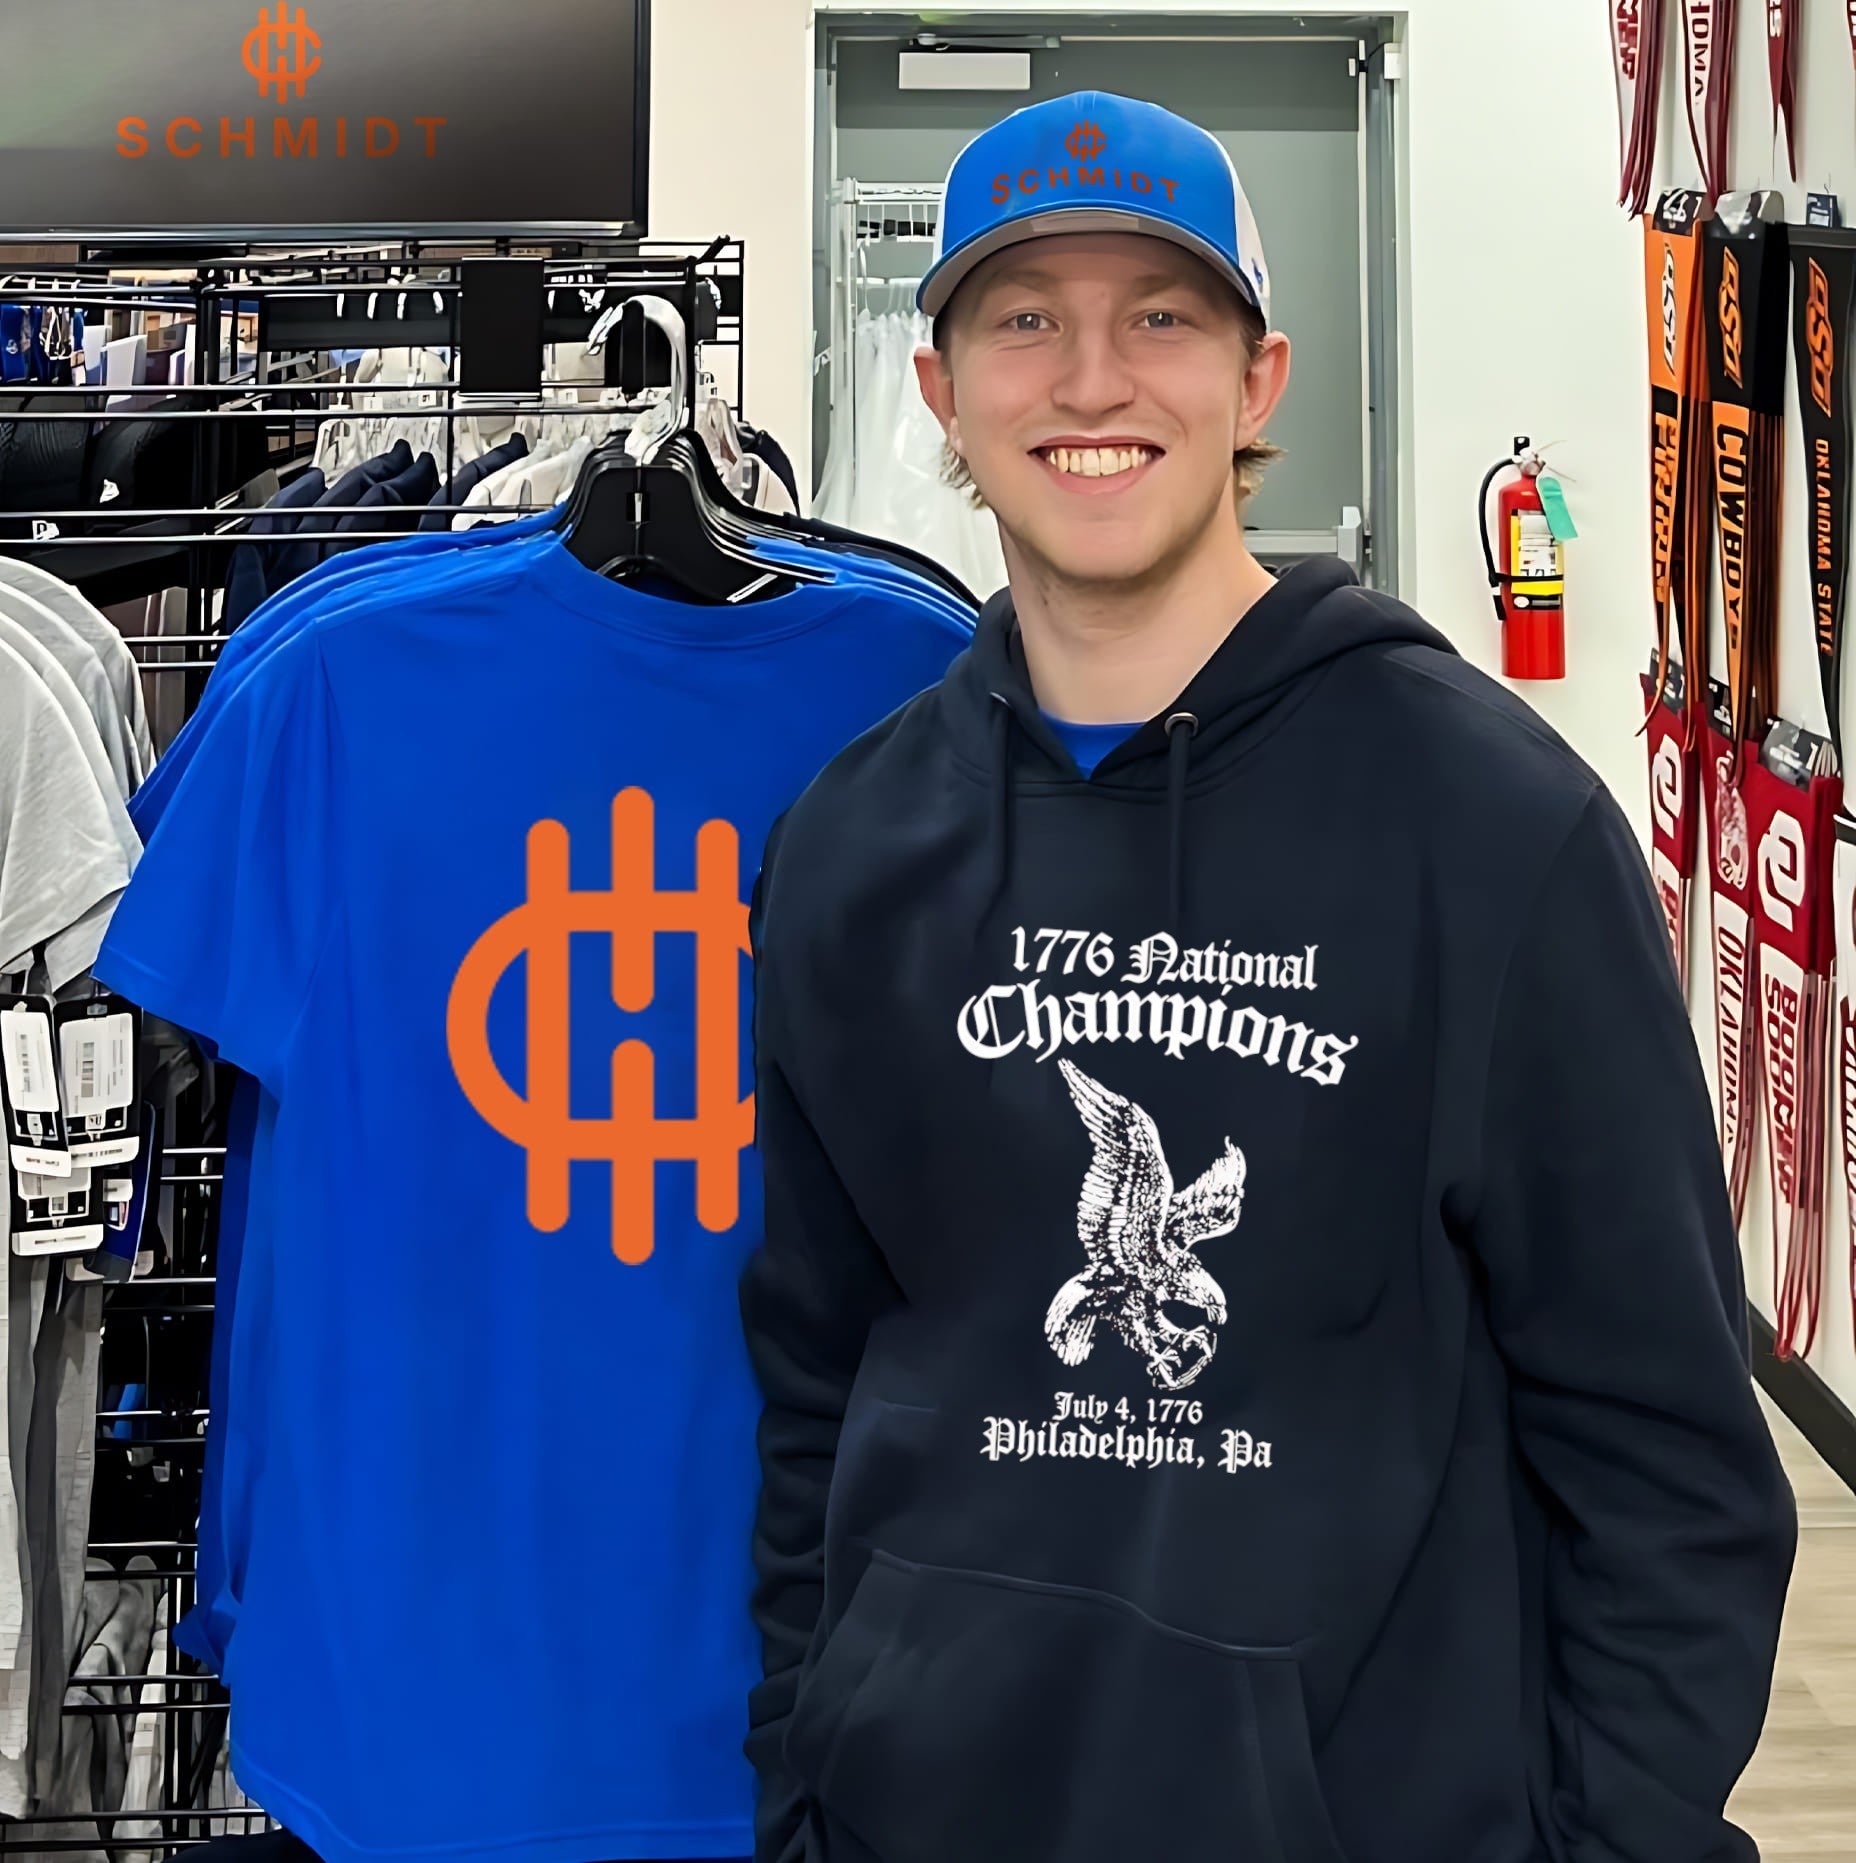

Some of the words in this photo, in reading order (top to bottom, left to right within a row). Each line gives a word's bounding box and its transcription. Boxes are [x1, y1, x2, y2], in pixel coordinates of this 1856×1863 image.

[115, 116, 447, 159] SCHMIDT
[991, 167, 1179, 204] SCHMIDT
[1815, 438, 1832, 570] OKLAHOMA
[1757, 809, 1806, 933] OU
[1011, 926, 1115, 975] 1776
[1121, 931, 1319, 990] National
[957, 978, 1359, 1086] Champions
[1052, 1391, 1107, 1423] July
[1114, 1396, 1136, 1422] 4,
[1147, 1398, 1203, 1423] 1776
[979, 1415, 1205, 1469] Philadelphia,
[1217, 1429, 1272, 1473] Pa
